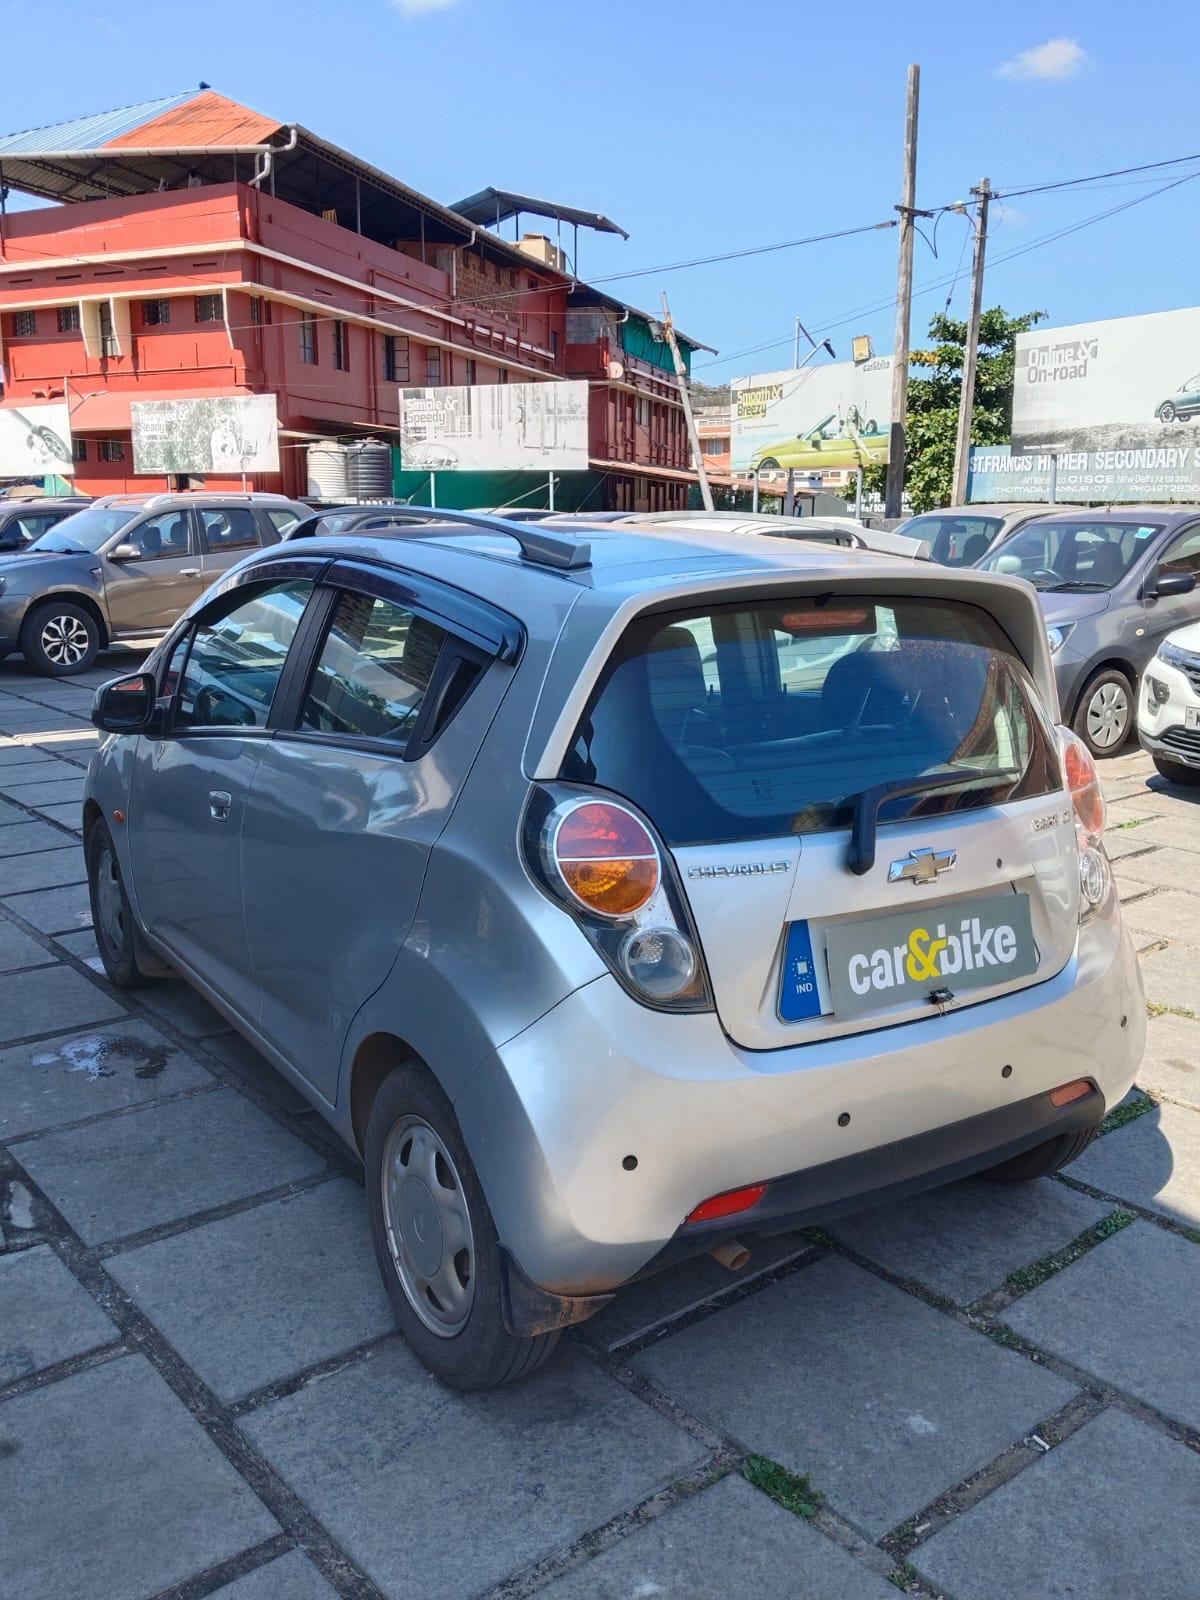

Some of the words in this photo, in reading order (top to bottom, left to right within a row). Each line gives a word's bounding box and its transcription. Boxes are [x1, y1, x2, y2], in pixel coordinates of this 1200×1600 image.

[1028, 344, 1075, 366] Online
[1077, 339, 1099, 360] &
[1027, 359, 1088, 384] On-road
[406, 398, 442, 411] Simple
[444, 395, 459, 410] &
[736, 387, 771, 404] Smooth
[771, 384, 784, 400] &
[407, 410, 447, 427] Speedy
[737, 403, 767, 418] Breezy
[1095, 447, 1191, 470] SECONDARY
[1068, 474, 1115, 484] CISCE
[687, 859, 793, 880] CHEVROLET
[848, 917, 1017, 995] car&bike
[795, 982, 813, 994] IND
